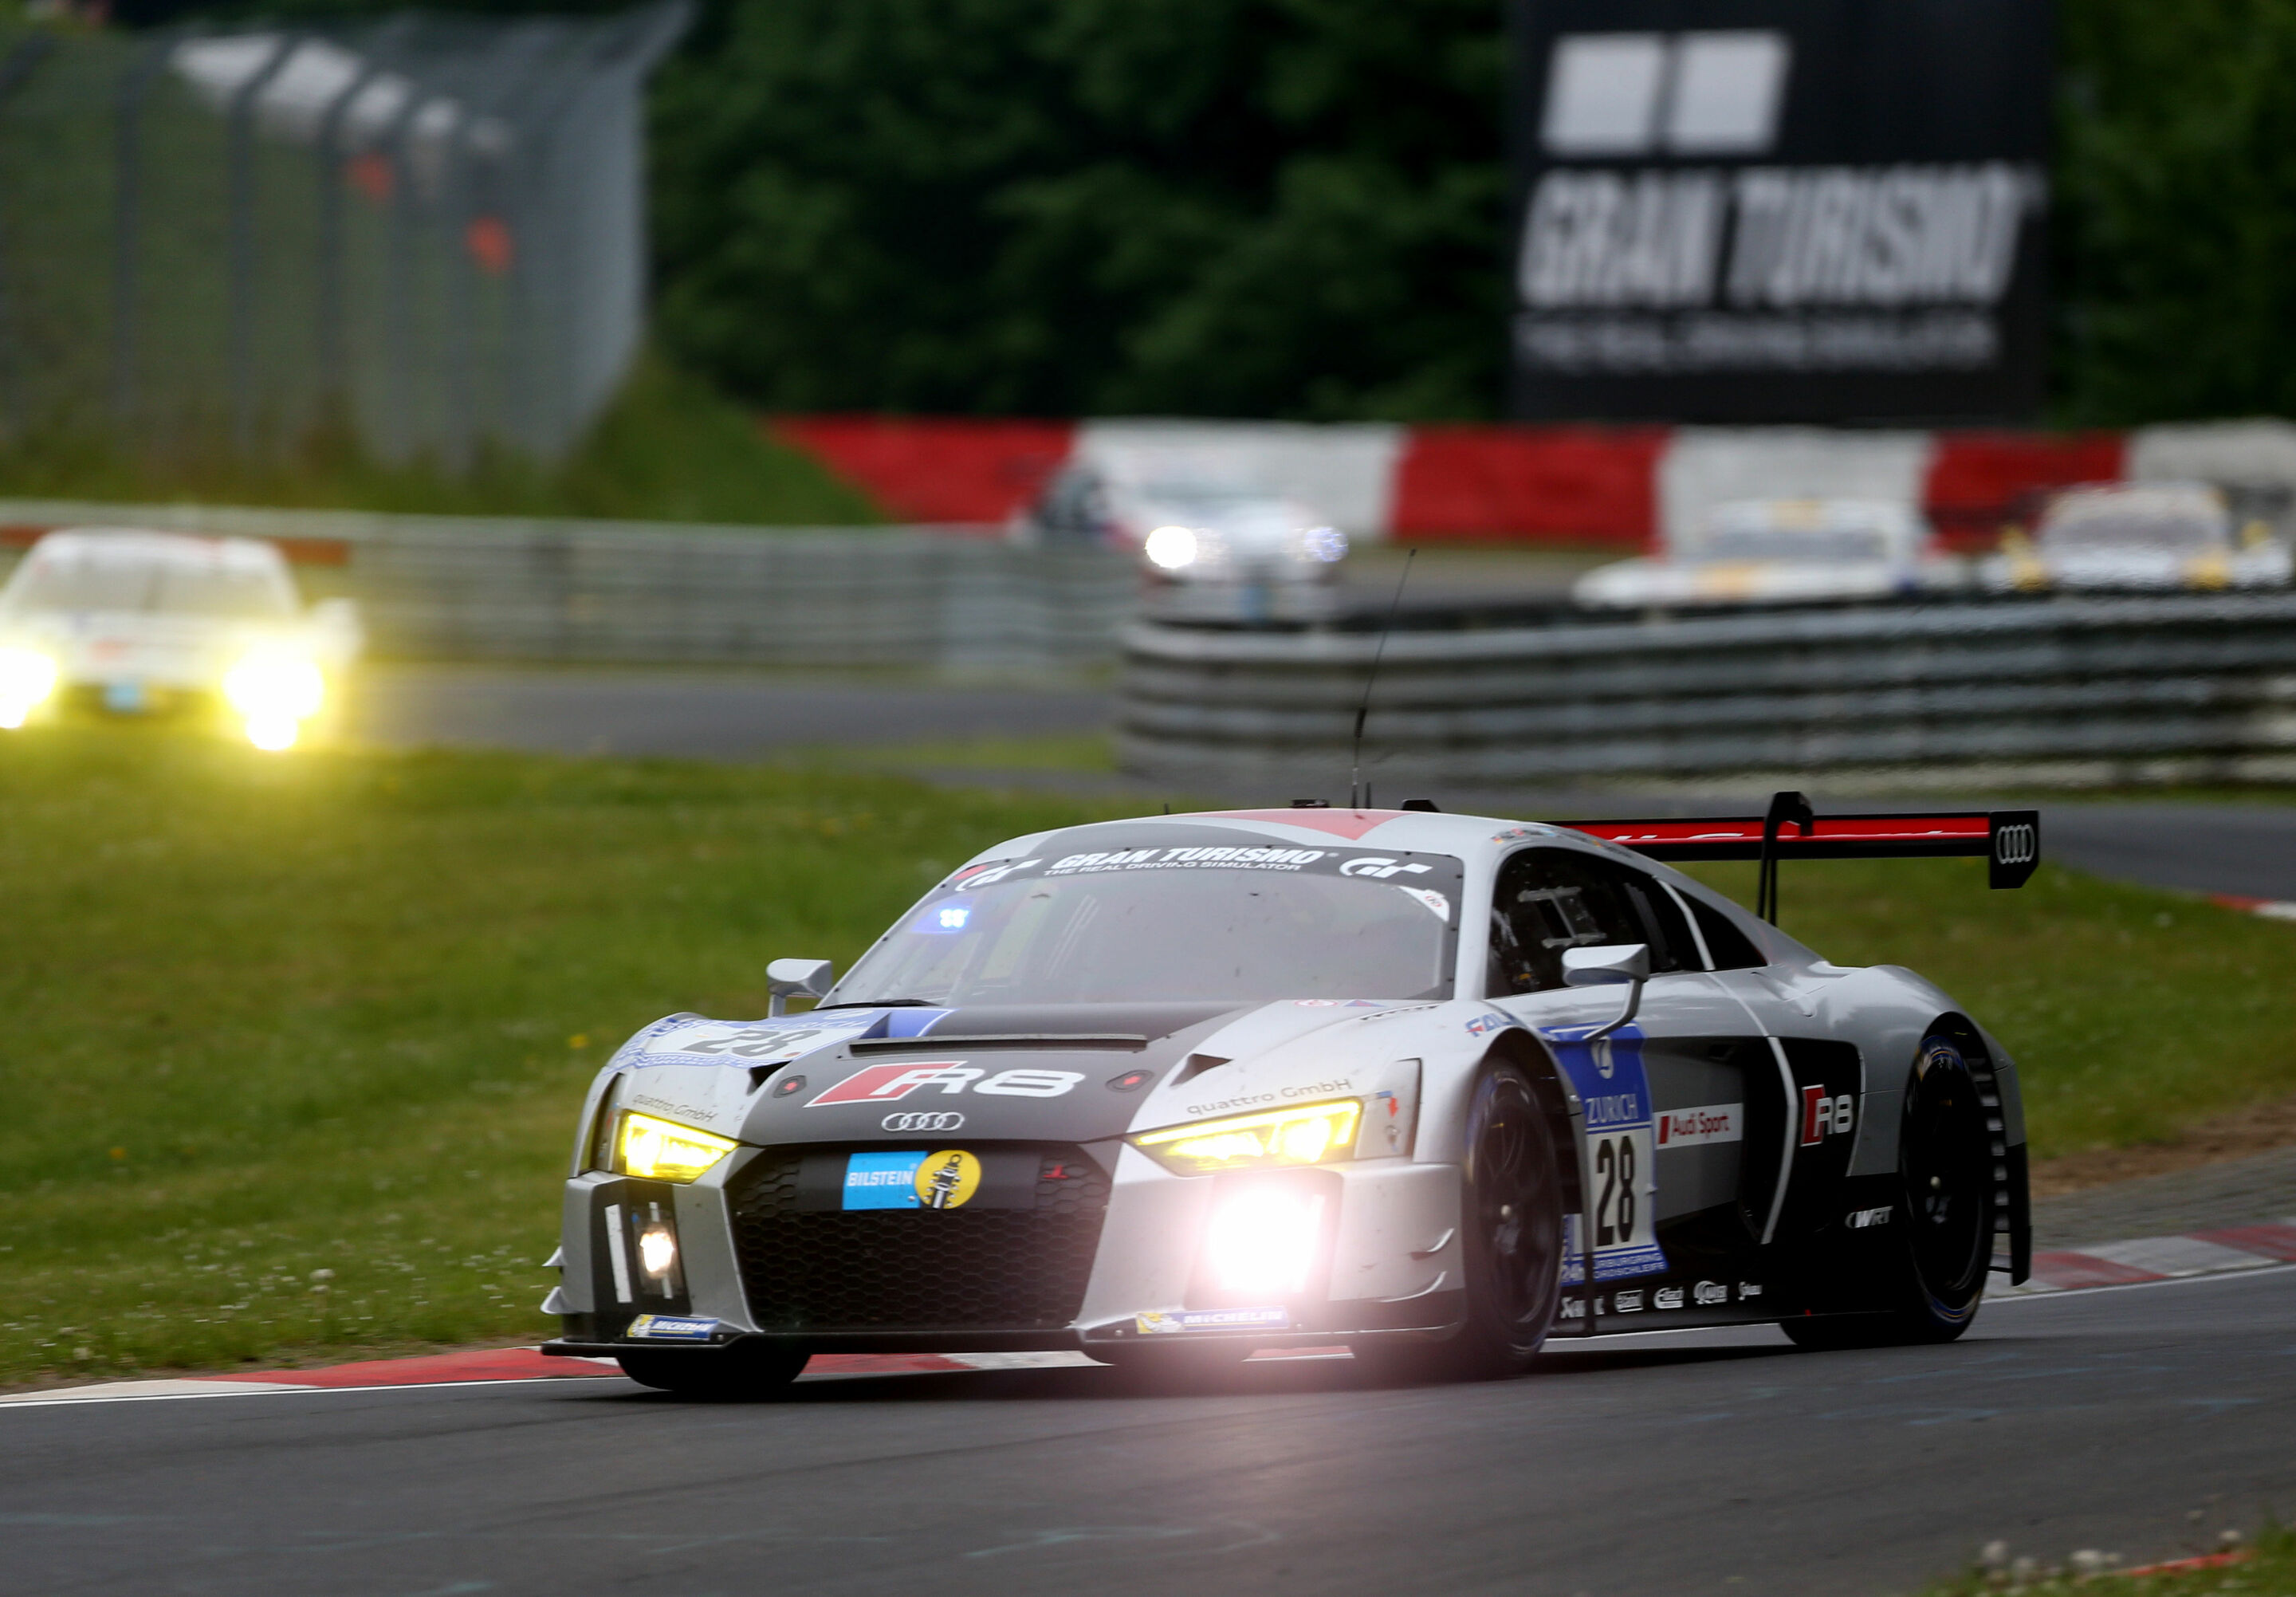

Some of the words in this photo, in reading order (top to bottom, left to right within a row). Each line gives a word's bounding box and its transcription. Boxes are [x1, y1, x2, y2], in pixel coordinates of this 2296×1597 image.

[1520, 167, 1720, 308] GRAN
[1727, 163, 2025, 308] TURISMO
[1051, 848, 1161, 869] GRAN
[1159, 847, 1325, 864] TURISMO
[1078, 863, 1121, 873] REAL
[1124, 861, 1197, 871] DRIVING
[1200, 861, 1301, 871] SIMULATOR
[1464, 1011, 1518, 1037] FAL
[680, 1029, 821, 1057] 28
[833, 1064, 1086, 1101] R8
[1186, 1092, 1276, 1115] quattro
[1280, 1078, 1353, 1098] GmbH
[674, 1103, 717, 1123] GmbH
[1586, 1094, 1638, 1123] ZURICH
[1807, 1091, 1854, 1140] R8
[1672, 1114, 1695, 1135] Audi
[1698, 1111, 1730, 1139] Sport
[847, 1170, 914, 1186] BILSTEIN
[1596, 1135, 1635, 1246] 28
[1184, 1310, 1284, 1324] MICHELIN
